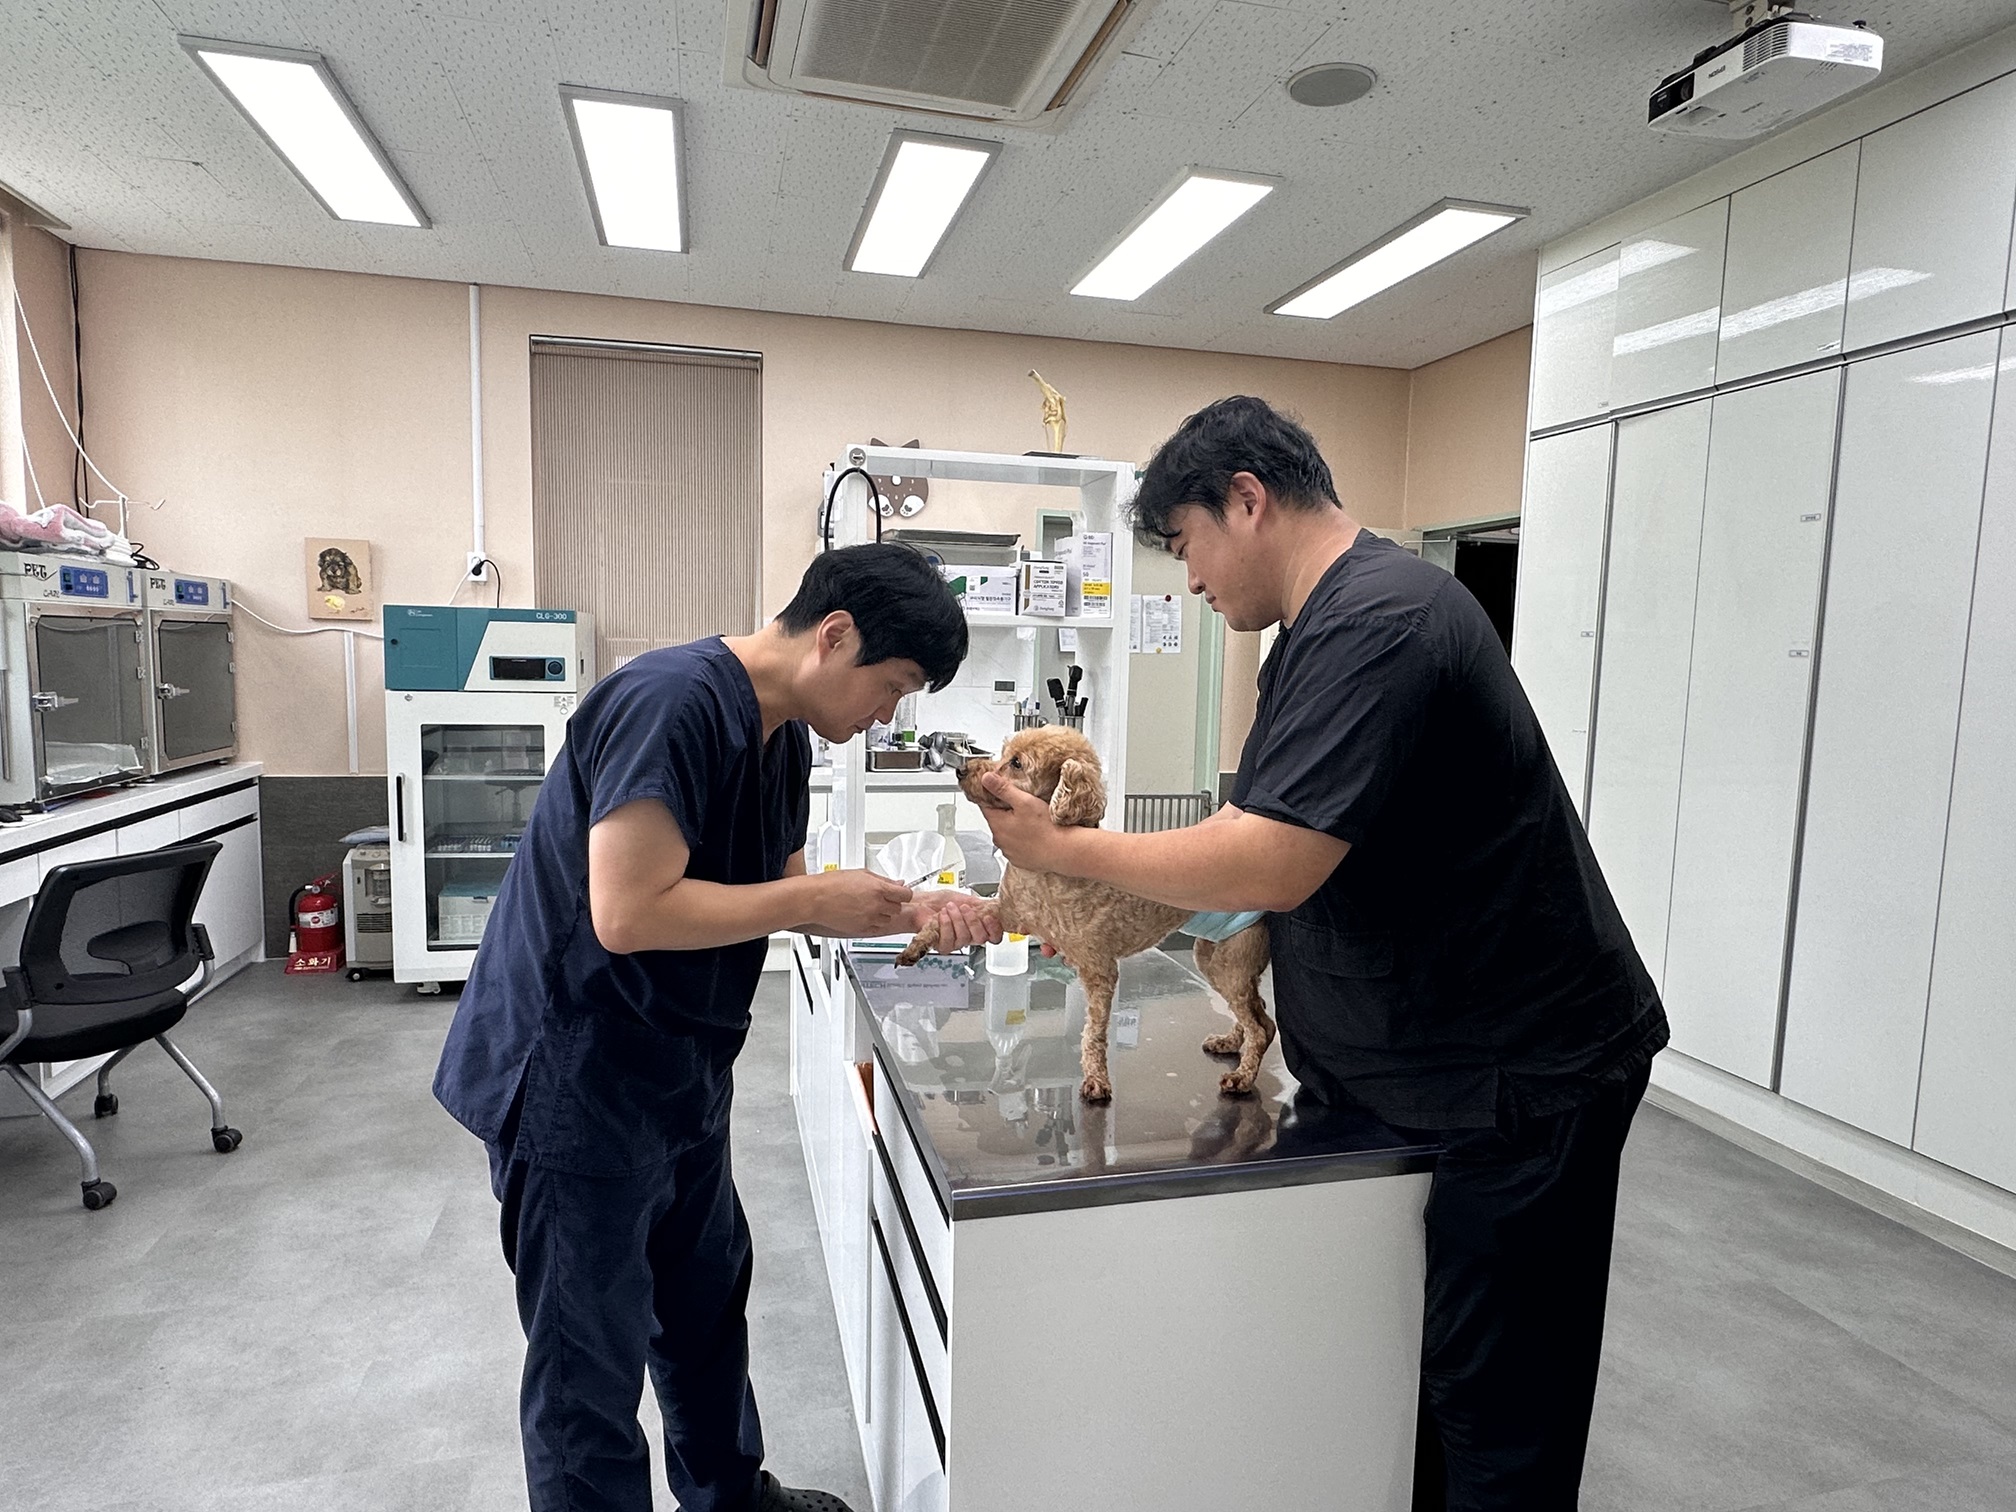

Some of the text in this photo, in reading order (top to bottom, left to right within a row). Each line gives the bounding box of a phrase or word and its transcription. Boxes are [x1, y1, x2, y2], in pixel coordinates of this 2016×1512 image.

[24, 563, 47, 579] PET
[150, 577, 166, 590] PET
[536, 612, 567, 620] CLG-300
[294, 957, 331, 967] 소화기
